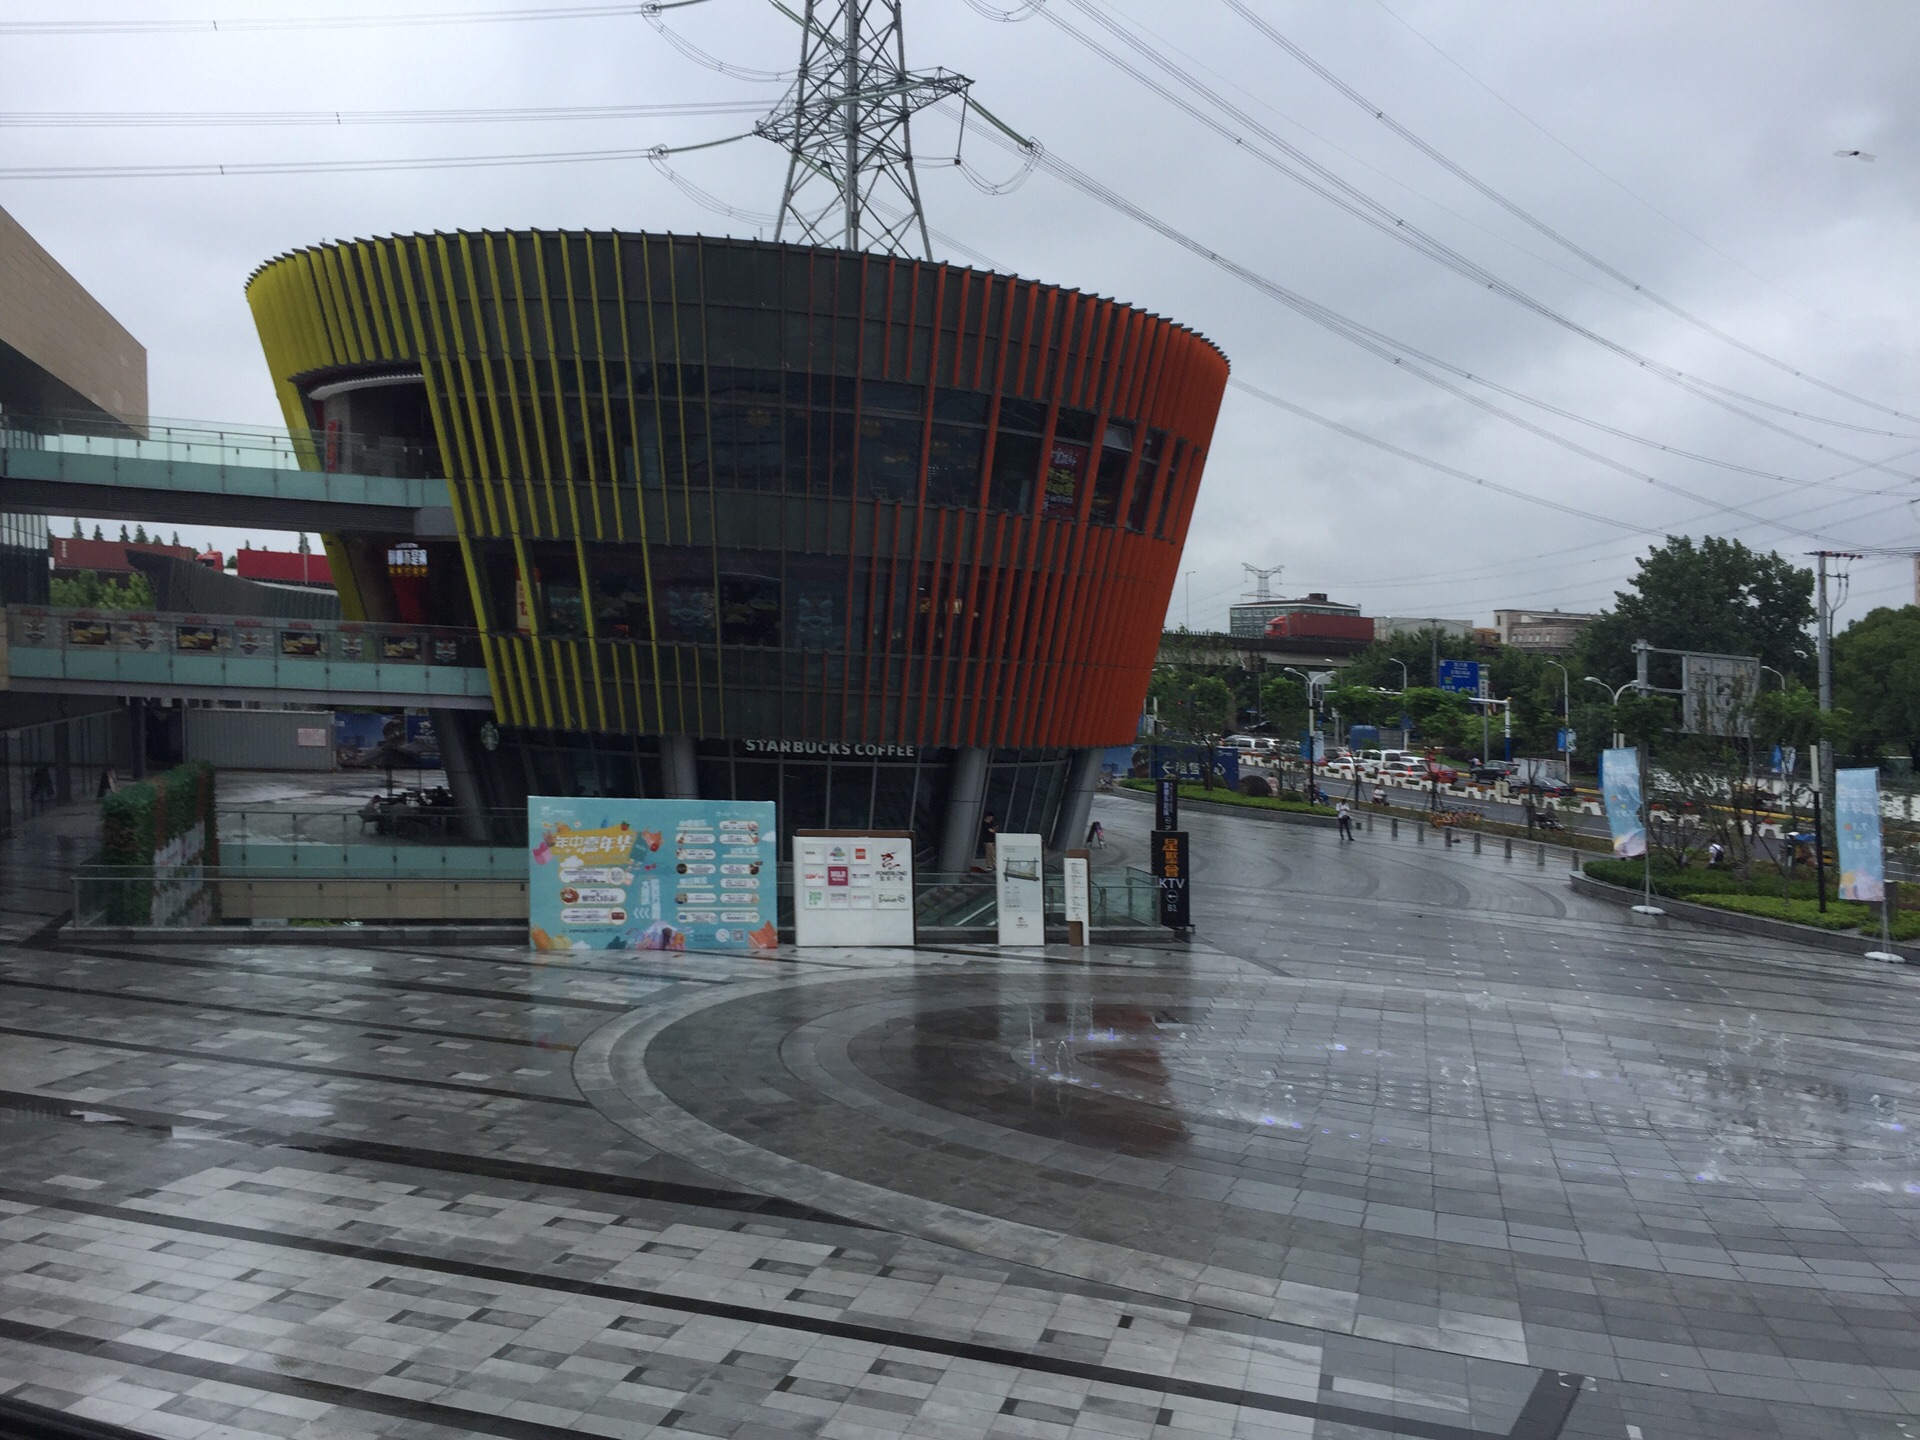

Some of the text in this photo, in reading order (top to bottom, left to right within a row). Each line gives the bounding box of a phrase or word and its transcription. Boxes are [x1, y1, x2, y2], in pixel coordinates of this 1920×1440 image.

[746, 739, 915, 757] STARBUCKS COFFEE
[555, 835, 632, 854] 年中嘉年华
[1159, 878, 1185, 889] KTV
